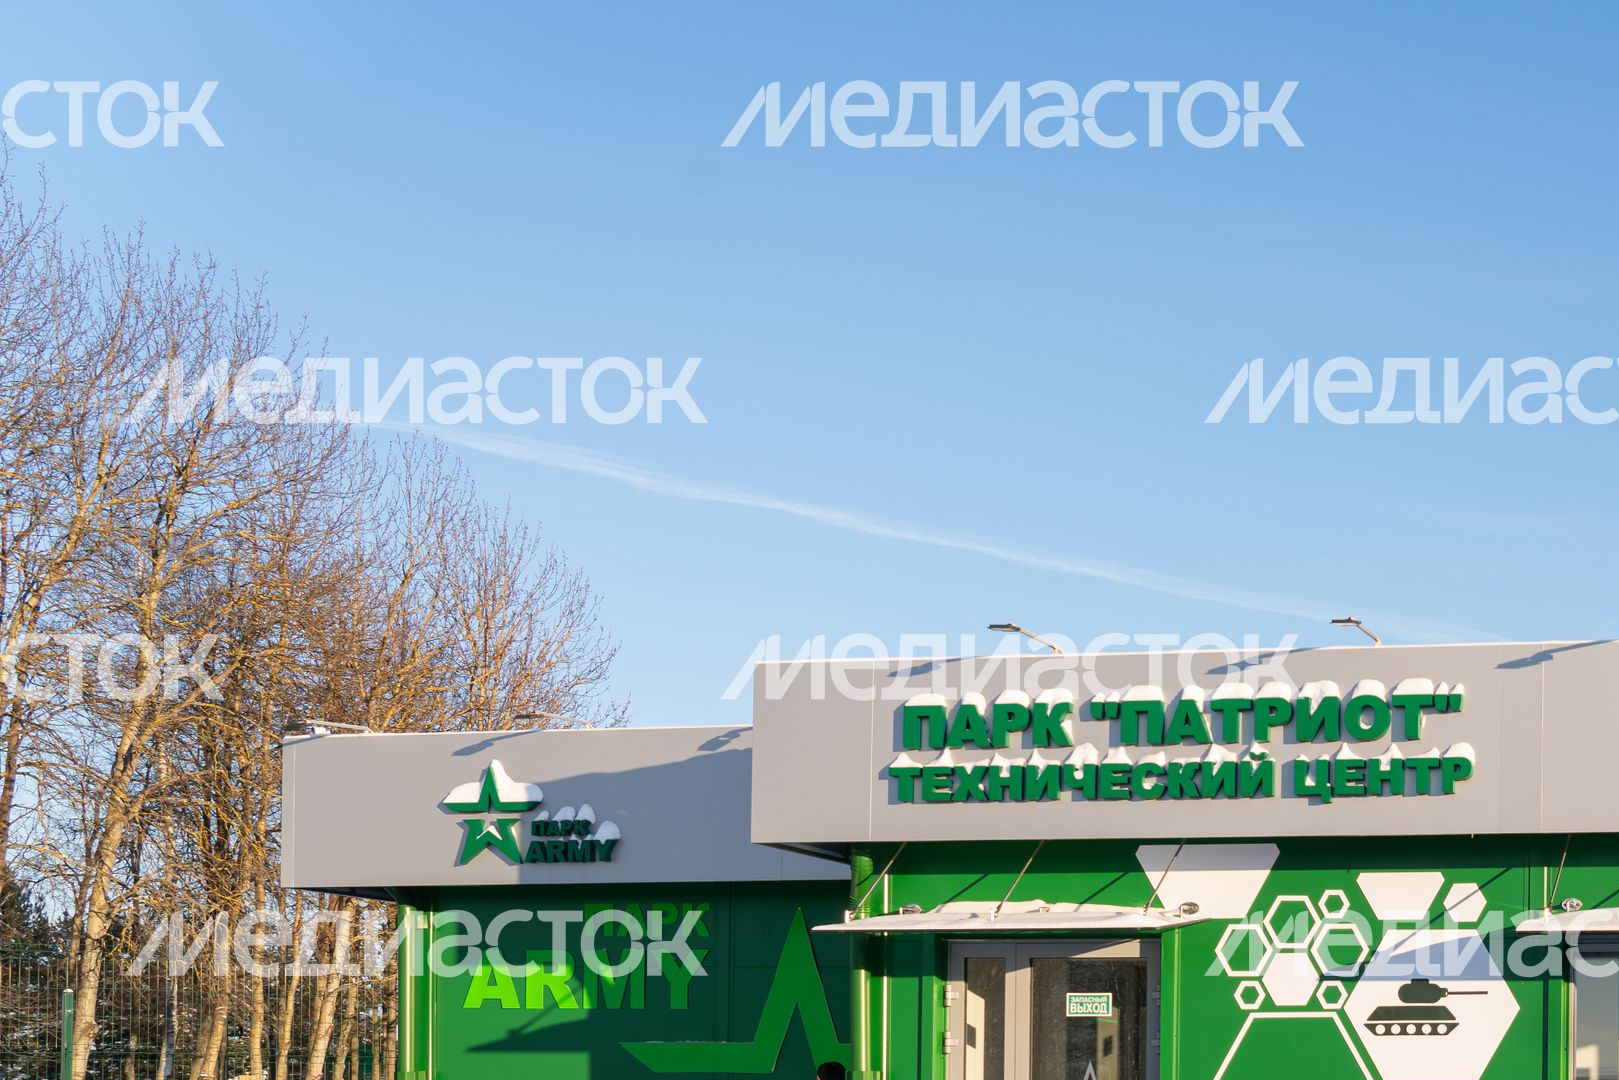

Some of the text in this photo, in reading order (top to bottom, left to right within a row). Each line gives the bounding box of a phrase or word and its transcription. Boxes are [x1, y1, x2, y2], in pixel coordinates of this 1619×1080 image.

[903, 693, 1463, 749] ПАРК "ПАТРИОТ"
[889, 752, 1474, 803] ТЕХНИЧЕСКИЙ ЦЕНТР
[531, 819, 592, 837] ПАРК
[525, 839, 621, 863] ARMY
[583, 903, 711, 937] ПАРК
[463, 949, 711, 1010] ARMY
[1070, 1003, 1107, 1013] ВЫХОД
